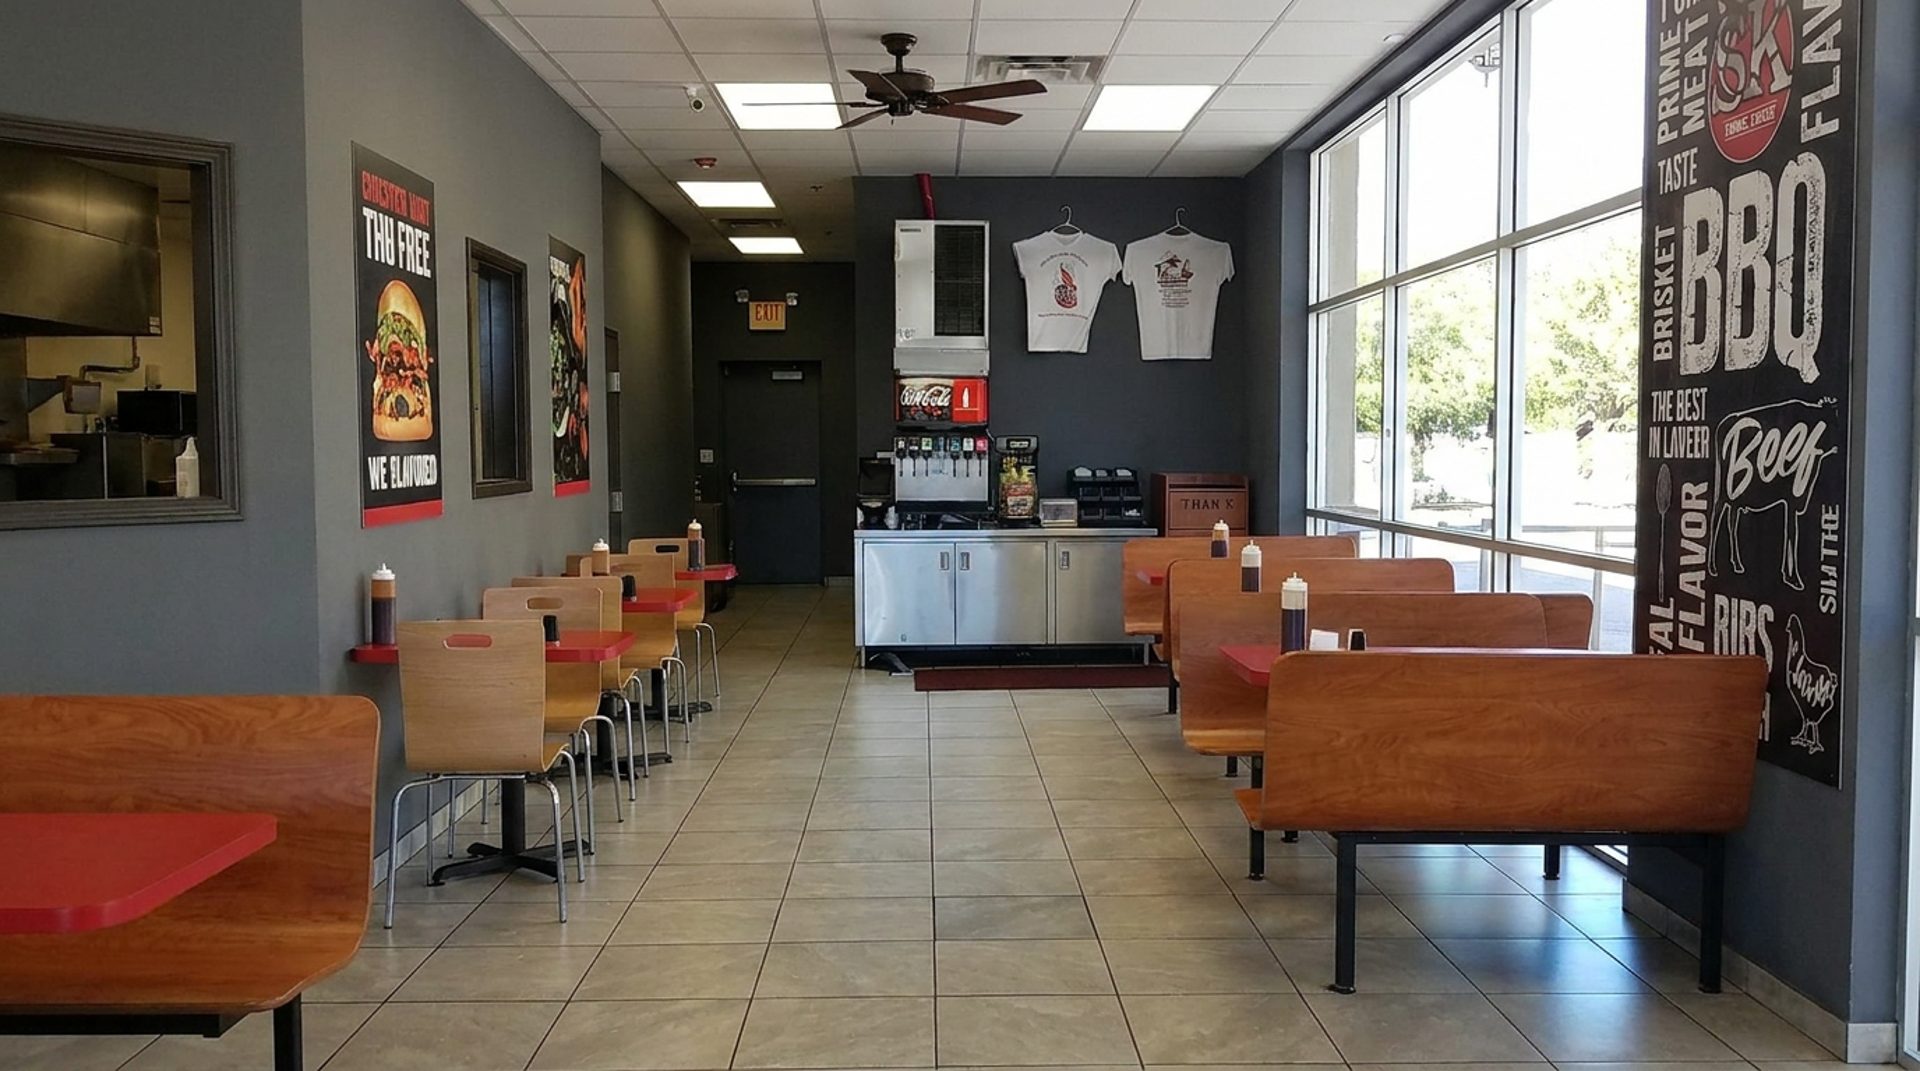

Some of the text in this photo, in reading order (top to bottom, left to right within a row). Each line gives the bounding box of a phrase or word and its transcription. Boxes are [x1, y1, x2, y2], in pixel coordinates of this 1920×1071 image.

[1657, 21, 1681, 145] PRIME
[1682, 13, 1708, 136] MEAT
[1658, 147, 1698, 195] TASTE
[397, 221, 431, 278] FREE
[1680, 152, 1826, 383] BBQ
[1653, 225, 1675, 361] BRISKET
[1649, 426, 1661, 458] IN
[1651, 387, 1708, 422] THE BEST
[368, 455, 388, 490] WE
[1723, 417, 1827, 500] Beef
[1678, 482, 1708, 653] FLAVOR
